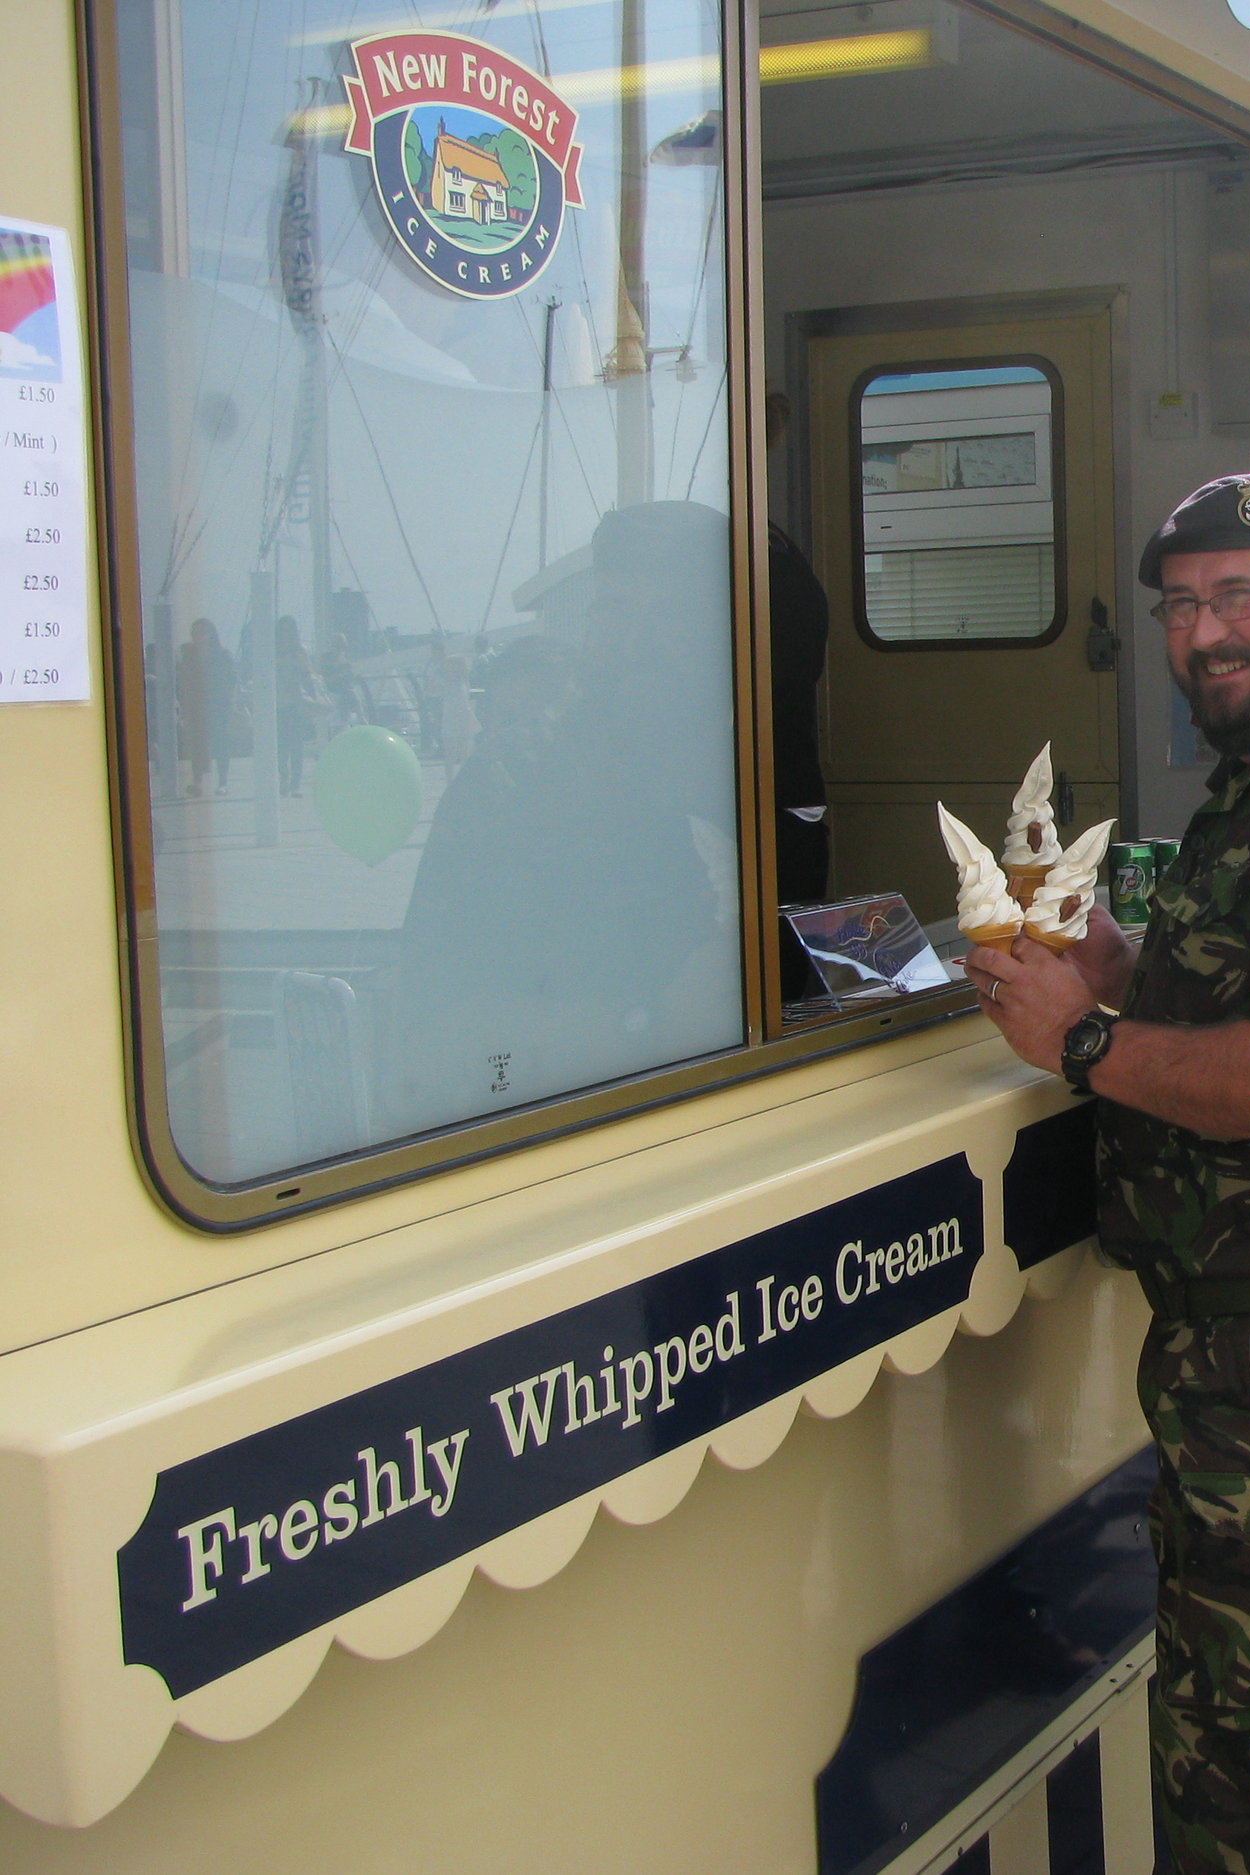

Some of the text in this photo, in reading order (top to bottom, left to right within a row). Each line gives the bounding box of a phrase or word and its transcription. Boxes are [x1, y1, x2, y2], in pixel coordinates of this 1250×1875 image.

[372, 50, 561, 146] New Forest
[391, 190, 551, 285] ICE CREAM
[19, 385, 55, 403] £1.50
[14, 432, 45, 450] Mint
[24, 480, 59, 497] £1.50
[25, 528, 61, 544] £2.50
[23, 575, 59, 591] £2.50
[24, 622, 60, 638] £1.50
[23, 668, 59, 685] £2.50
[177, 1216, 963, 1614] Freshly Whipped Ice Cream
